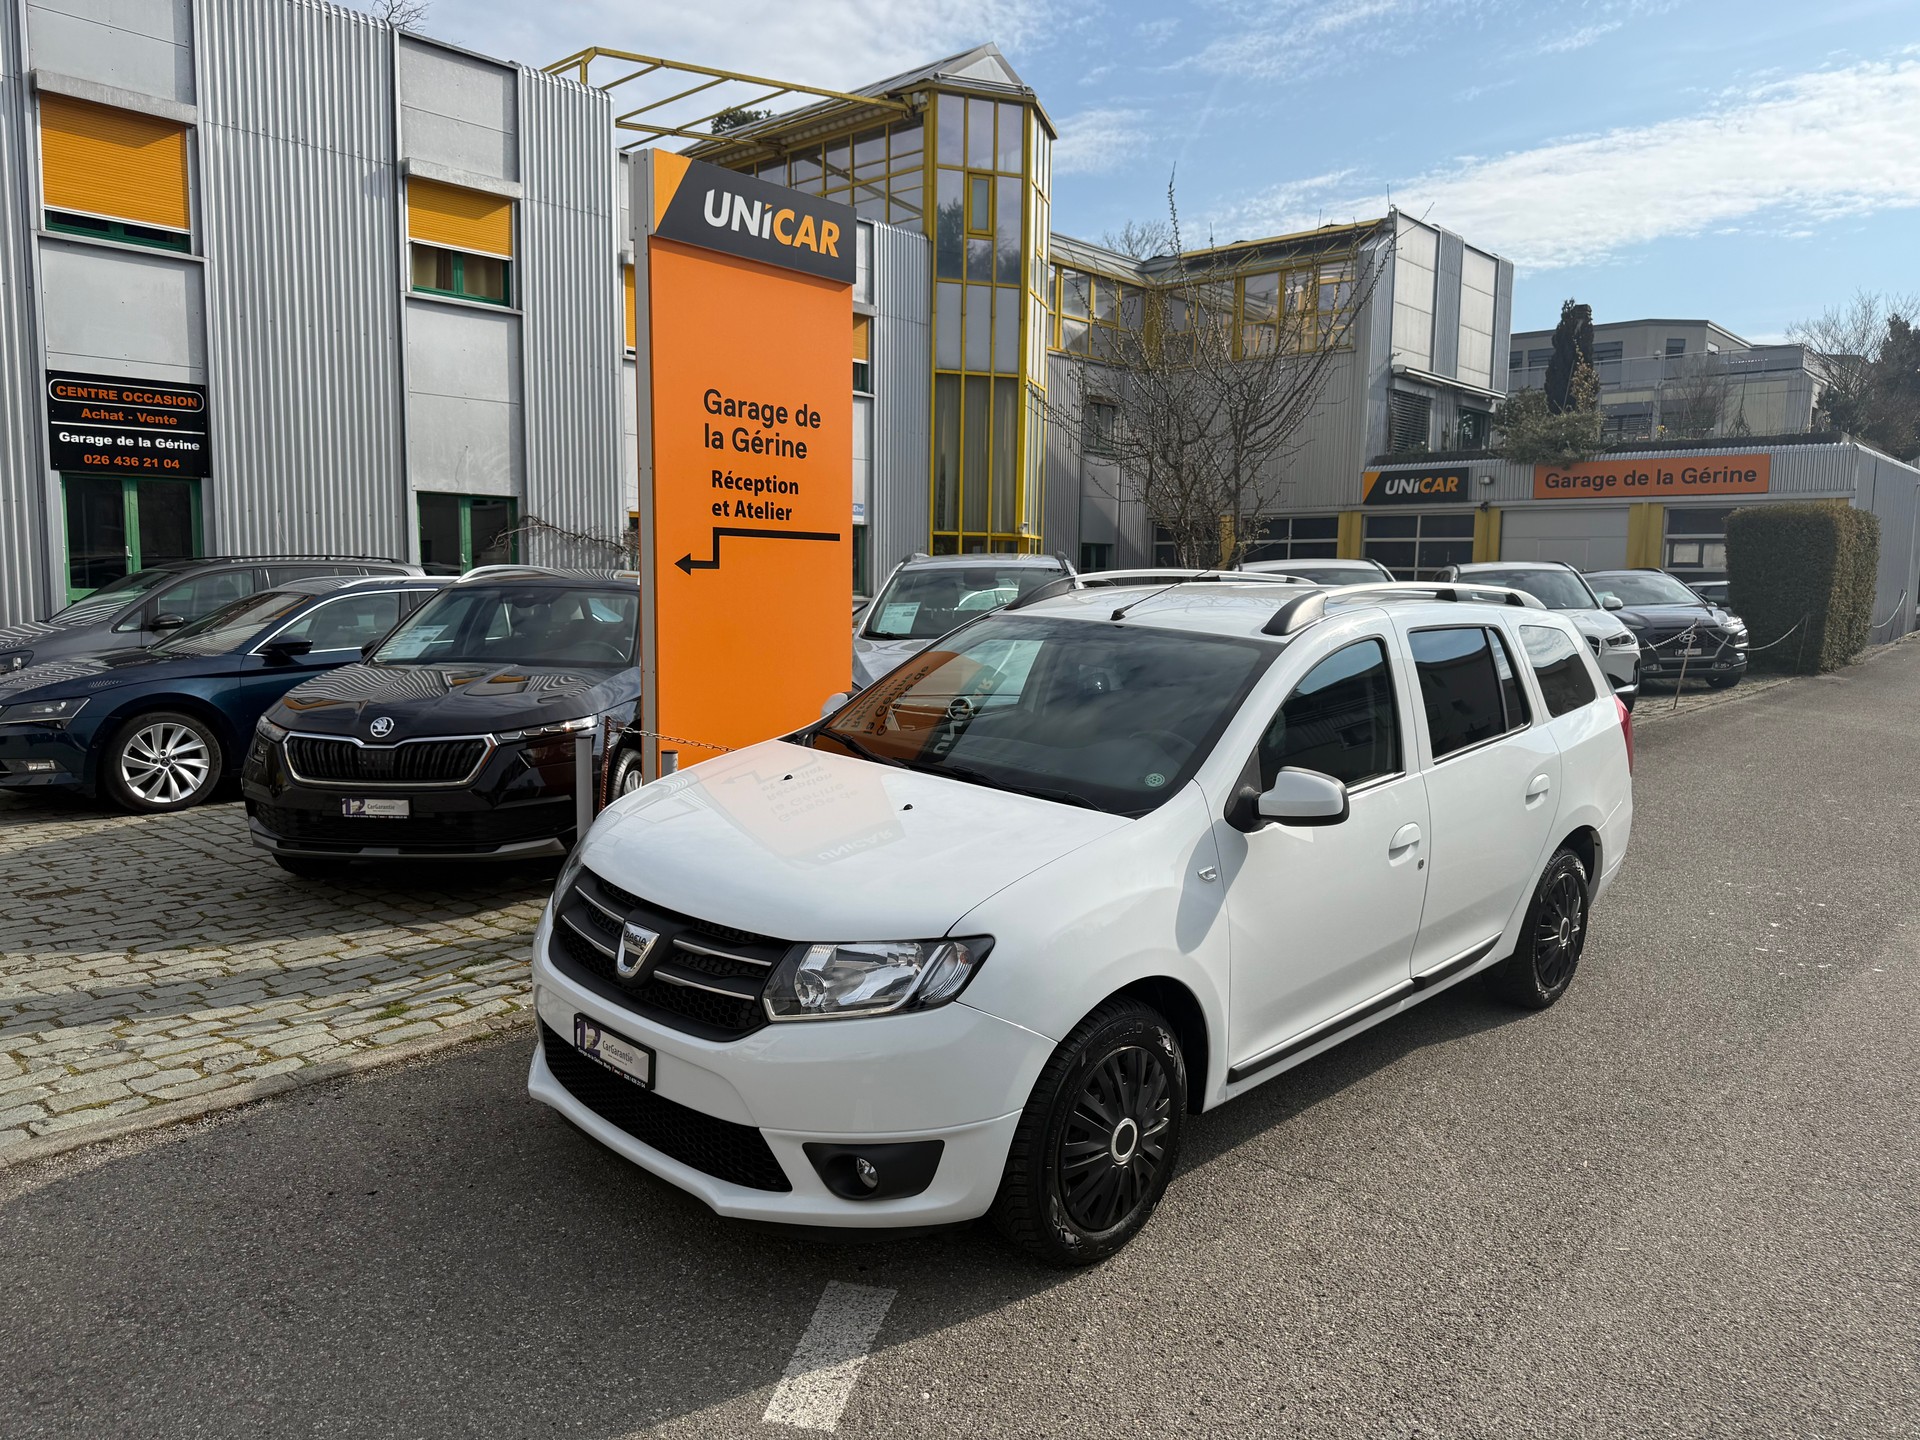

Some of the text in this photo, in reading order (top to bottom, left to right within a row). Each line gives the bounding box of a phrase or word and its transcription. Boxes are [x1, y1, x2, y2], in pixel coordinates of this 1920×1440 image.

[56, 385, 198, 408] CENTRE OCCASION
[81, 407, 125, 422] Achat
[136, 412, 178, 426] Vente
[703, 388, 821, 429] Garage de
[58, 431, 200, 451] Garage de la Gérine
[704, 422, 808, 460] la Gérine
[83, 454, 181, 469] 026 436 21 04
[711, 469, 800, 497] Réception
[1545, 466, 1758, 491] Garage de la Gérine
[711, 499, 793, 521] et Atelier
[342, 798, 366, 815] 12
[624, 931, 647, 945] DACIA
[576, 1018, 602, 1058] 12
[602, 1040, 634, 1064] CarGarantie
